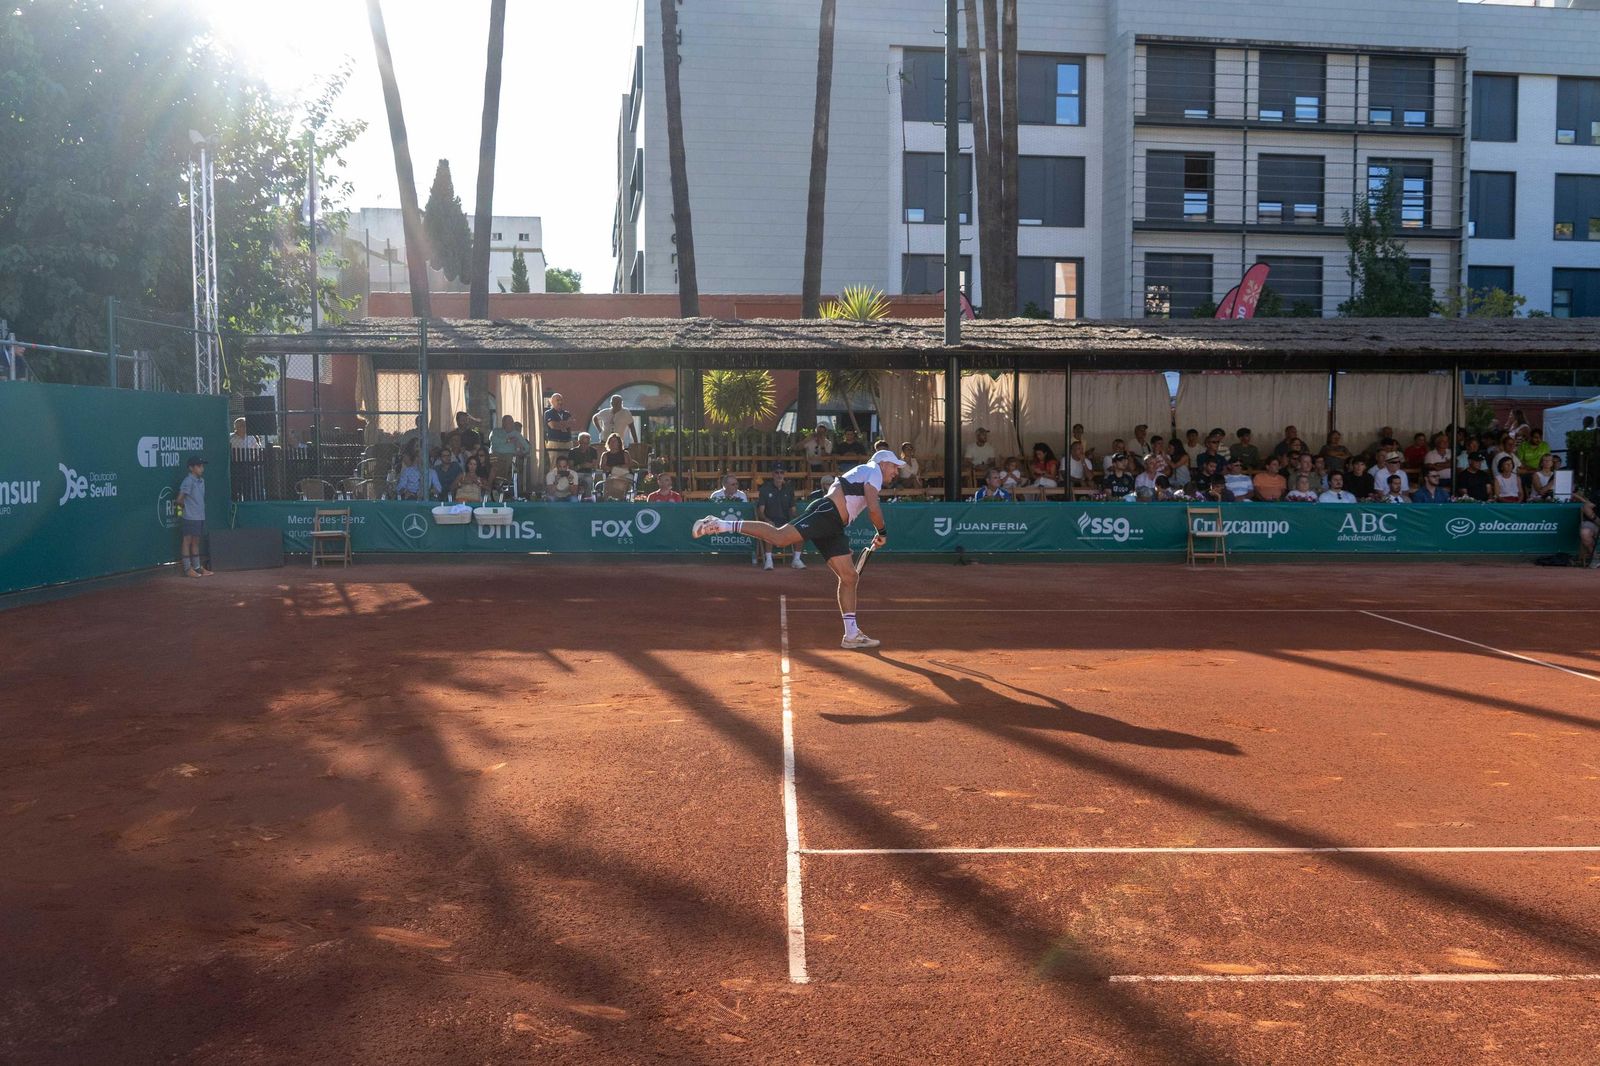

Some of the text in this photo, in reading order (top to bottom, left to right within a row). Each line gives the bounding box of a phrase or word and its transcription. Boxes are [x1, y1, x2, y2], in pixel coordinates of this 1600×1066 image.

[160, 436, 204, 451] CHALLENGER
[160, 452, 180, 467] TOUR
[90, 482, 117, 498] Sevilla
[287, 515, 366, 524] Mercdes-Benz
[1338, 512, 1398, 533] ABC
[1478, 519, 1559, 531] solocanarias
[591, 520, 633, 538] FOX
[710, 536, 752, 544] PROCISA
[1337, 533, 1397, 542] abcdesevilla.es
